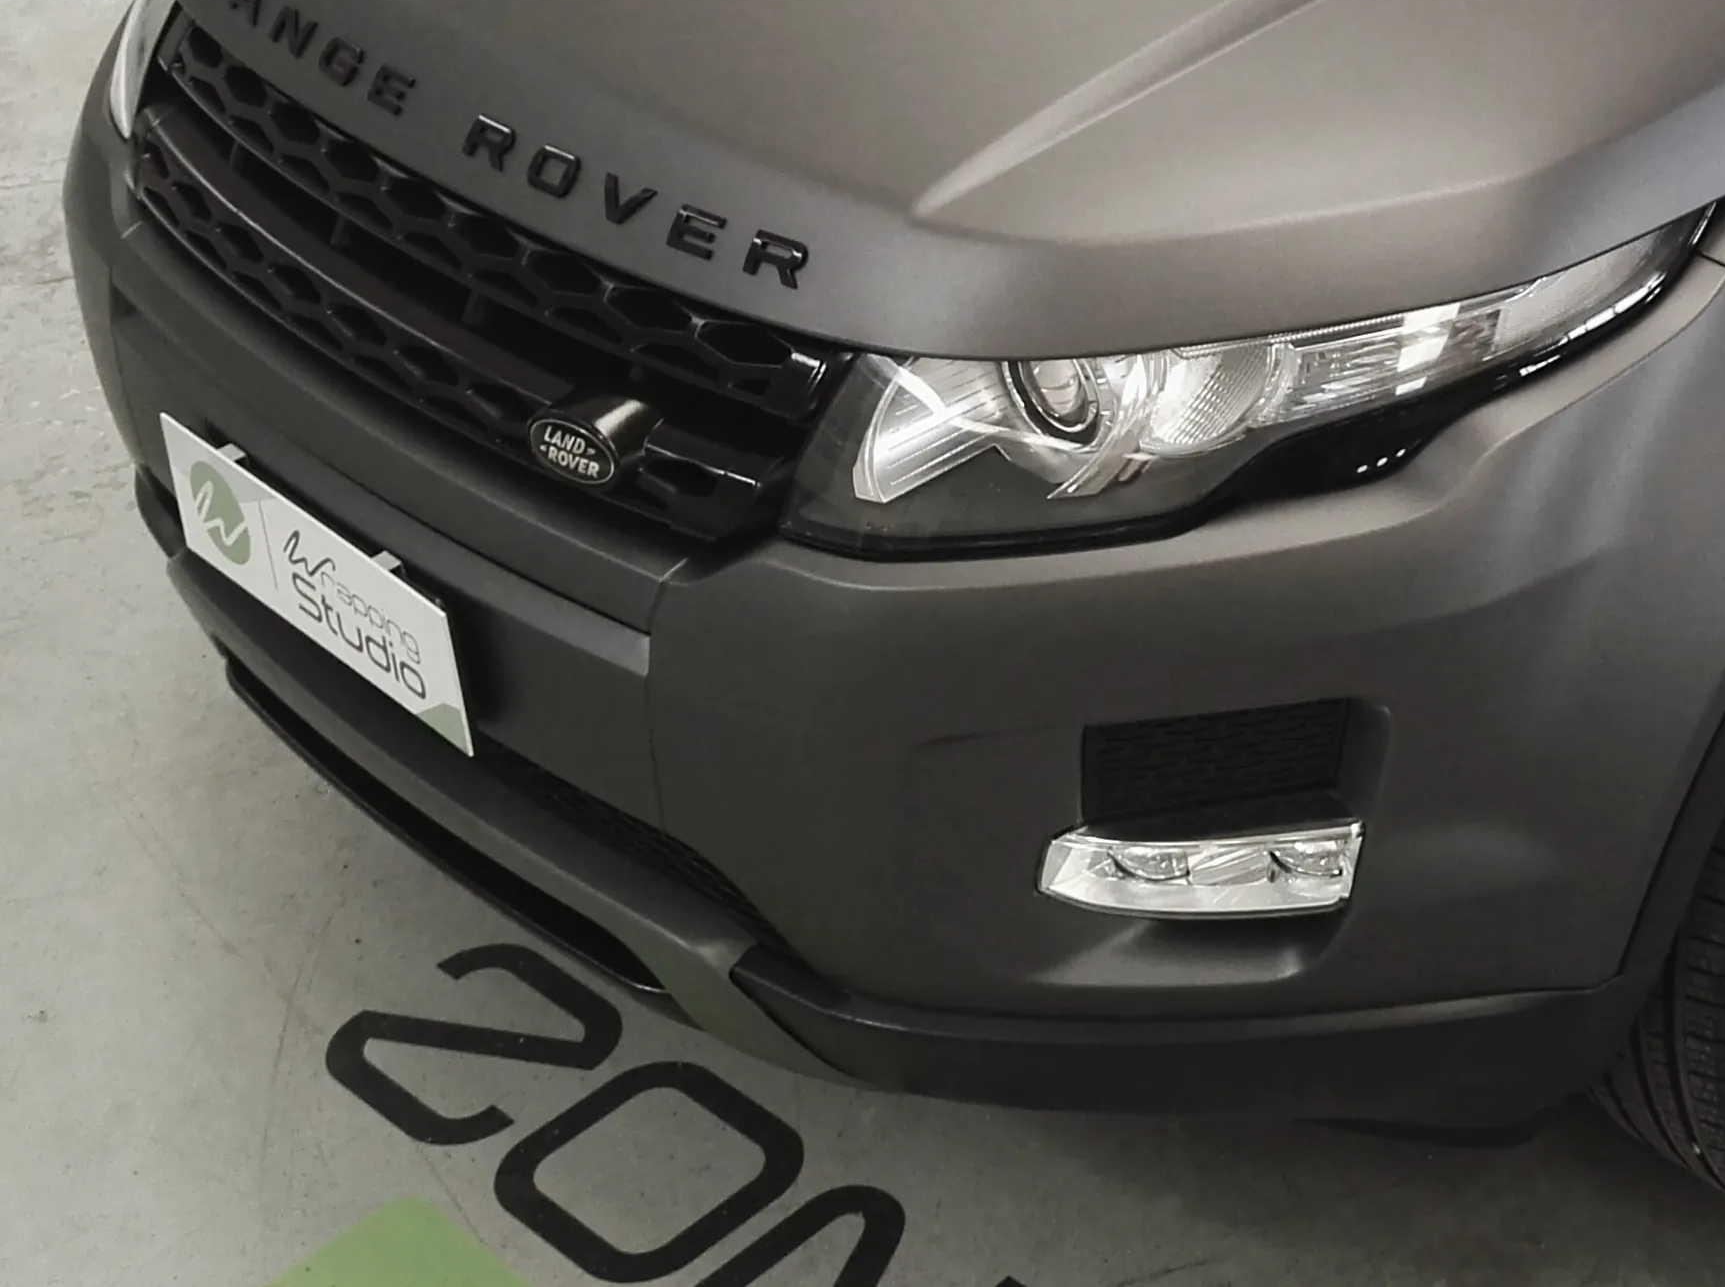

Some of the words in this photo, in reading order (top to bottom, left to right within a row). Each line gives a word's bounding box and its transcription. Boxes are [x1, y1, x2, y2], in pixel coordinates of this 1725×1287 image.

[463, 114, 808, 290] ROVER
[543, 425, 586, 455] LAND
[548, 446, 600, 478] ROVER
[283, 529, 421, 665] Wrapping
[292, 572, 426, 700] Studio
